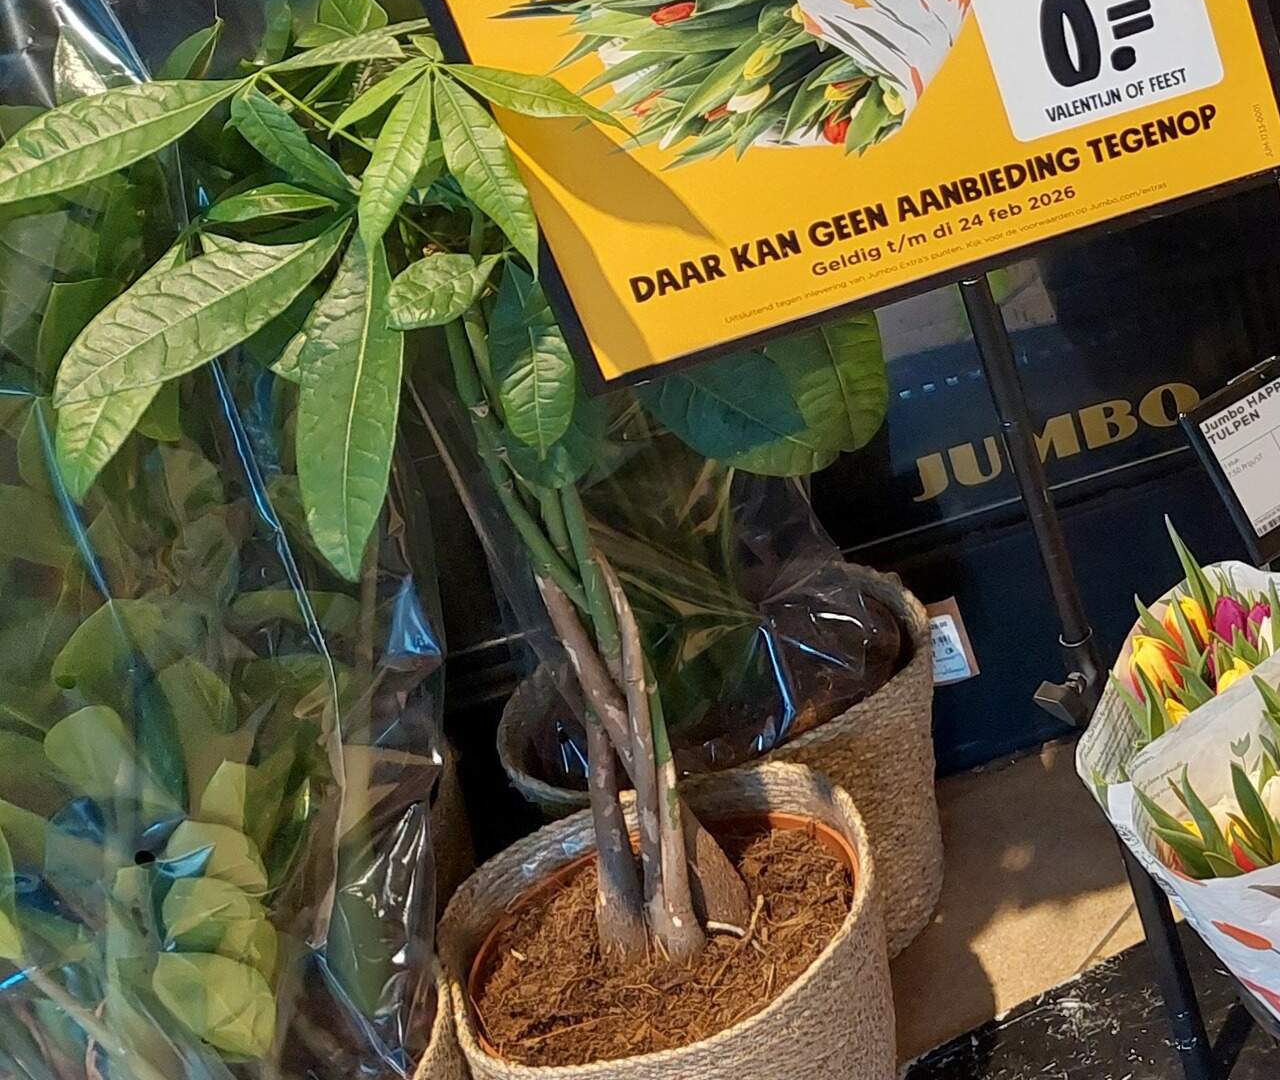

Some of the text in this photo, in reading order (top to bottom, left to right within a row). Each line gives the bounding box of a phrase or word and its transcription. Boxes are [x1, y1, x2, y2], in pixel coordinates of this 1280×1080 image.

[1045, 68, 1187, 122] VALENTIJN OF FEEST
[629, 103, 1217, 303] DAAR KAN GEEN AANBIEDING TEGENOP
[812, 185, 1076, 277] Geldig t/m di 24 feb 2026
[775, 294, 802, 309] tegen
[803, 280, 847, 300] inlevering
[848, 275, 865, 285] van
[866, 263, 898, 279] Jumbo
[899, 254, 928, 269] Extra's
[965, 238, 981, 248] Kijk
[983, 232, 1003, 243] voor
[1005, 227, 1017, 236] de
[1018, 210, 1074, 232] voorwaarden
[1075, 207, 1087, 216] op
[913, 382, 1200, 502] JUMBO
[1203, 405, 1245, 434] Jumbo
[1208, 409, 1261, 445] TULPEN
